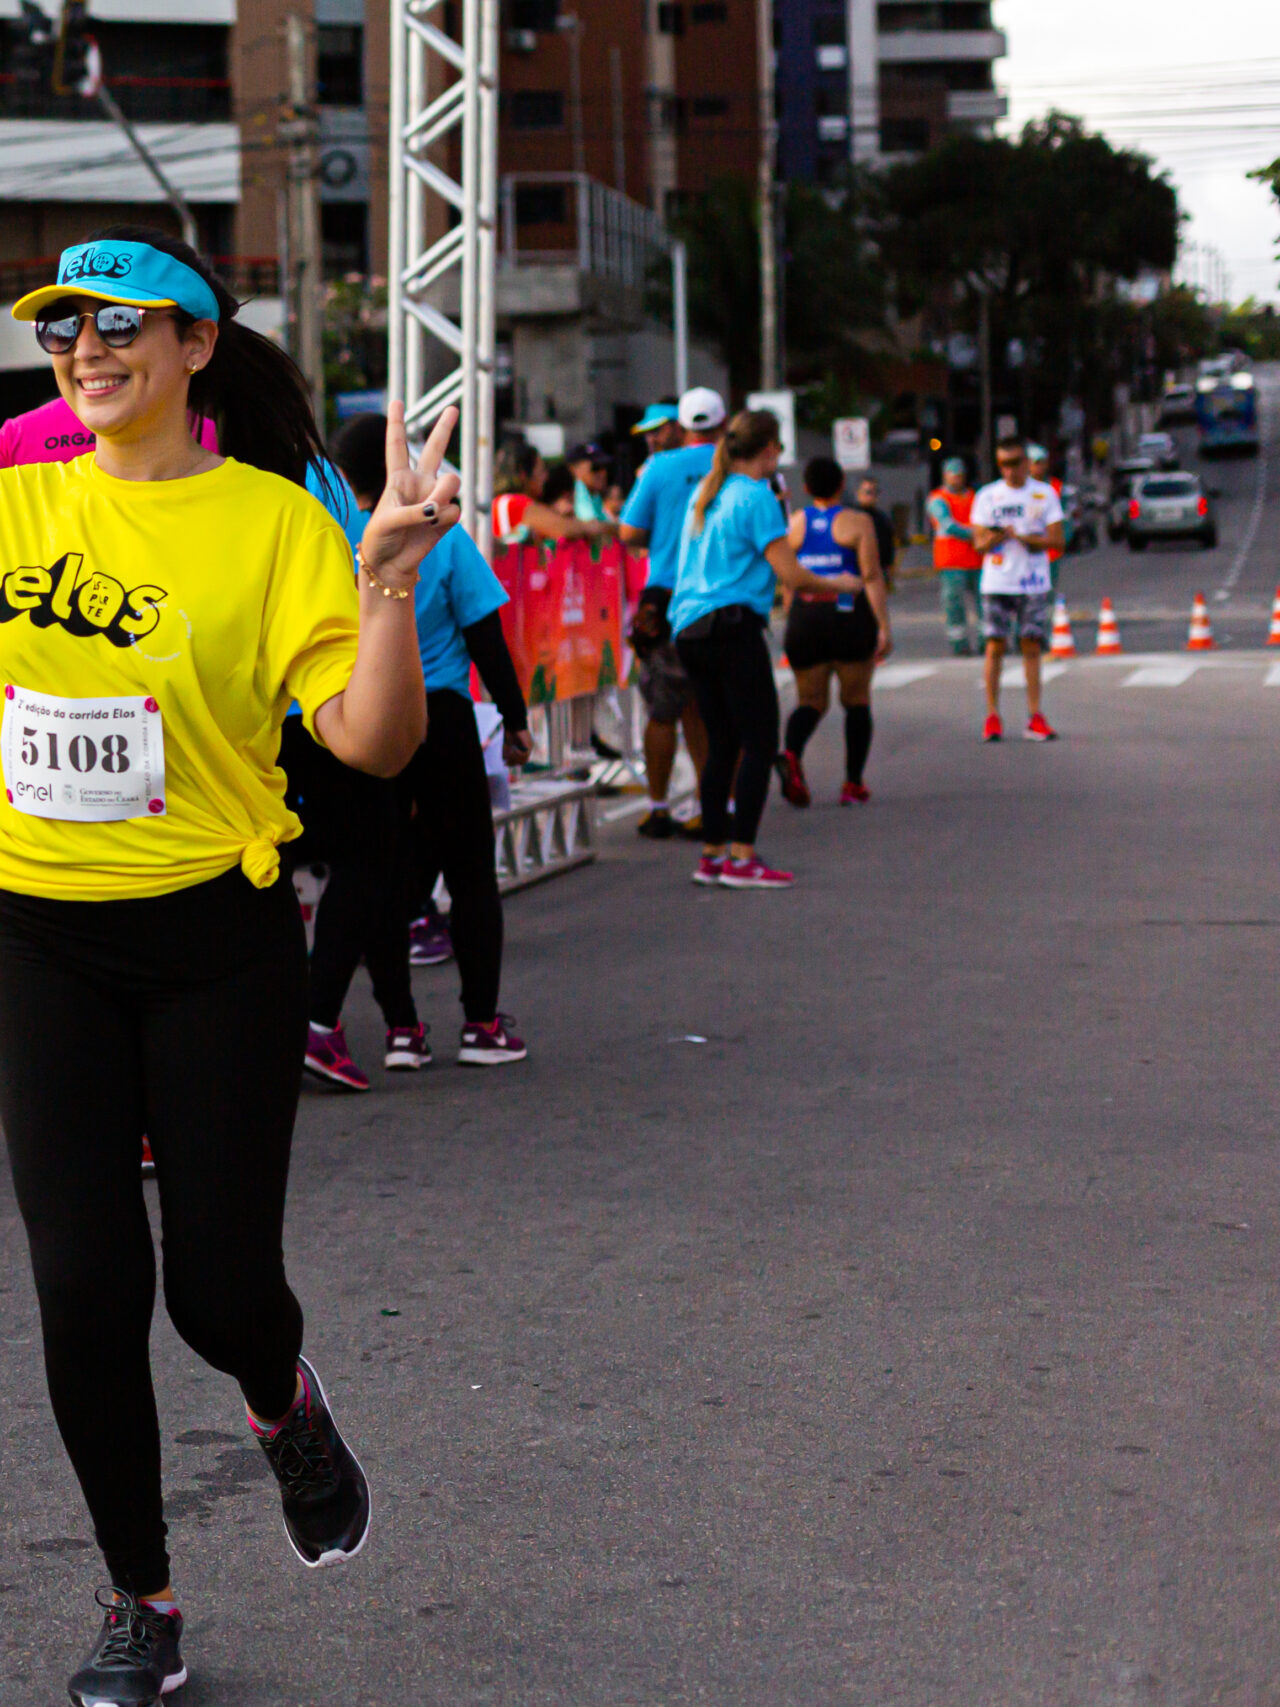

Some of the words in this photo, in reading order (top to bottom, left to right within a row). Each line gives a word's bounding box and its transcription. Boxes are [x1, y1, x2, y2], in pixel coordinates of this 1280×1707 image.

[62, 247, 133, 284] elos
[25, 703, 51, 718] edição
[53, 709, 65, 719] da
[69, 709, 109, 720] corrida
[112, 708, 136, 719] Elos
[21, 726, 130, 774] 5108
[16, 781, 53, 802] enel
